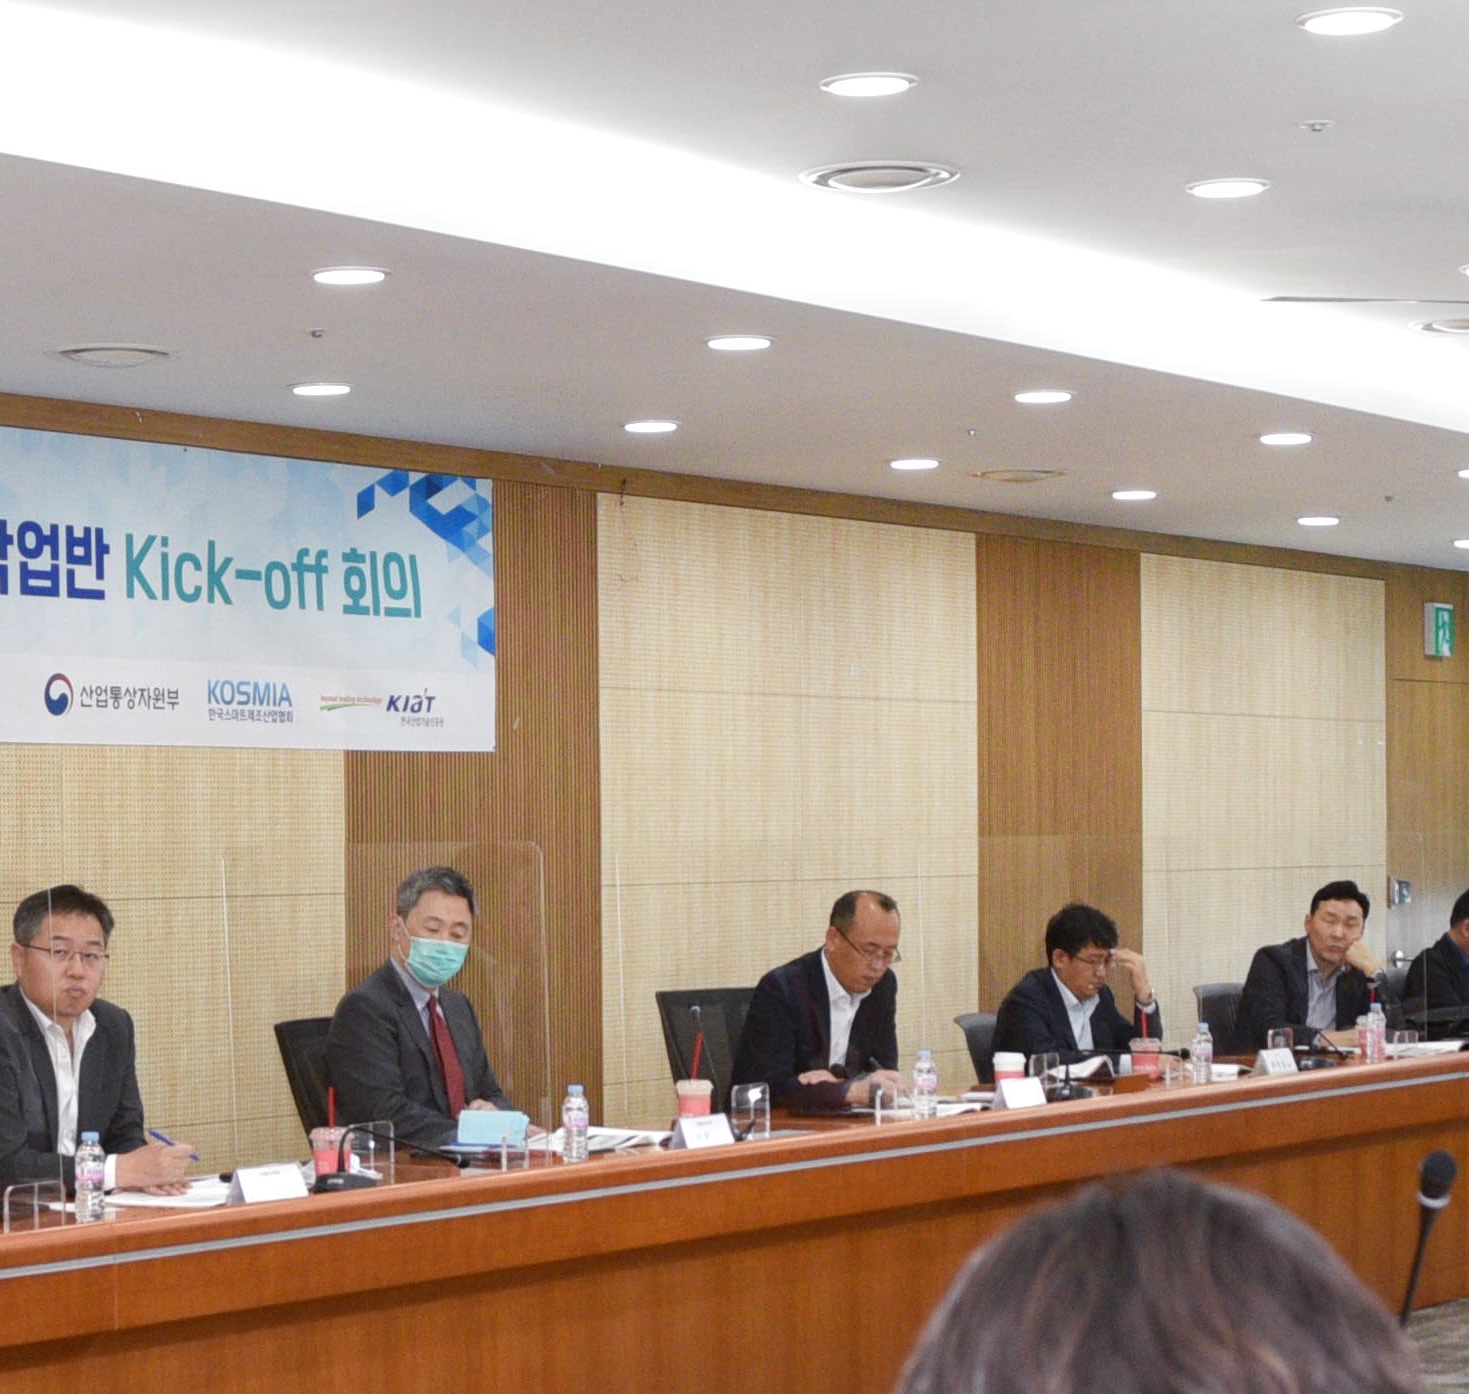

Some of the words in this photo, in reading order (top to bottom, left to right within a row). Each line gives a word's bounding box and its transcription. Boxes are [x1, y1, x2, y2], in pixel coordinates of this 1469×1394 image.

[126, 534, 328, 610] Kick-off
[342, 548, 421, 617] 회의
[80, 685, 179, 710] 산업통상자원부
[208, 680, 292, 707] KOSMIA
